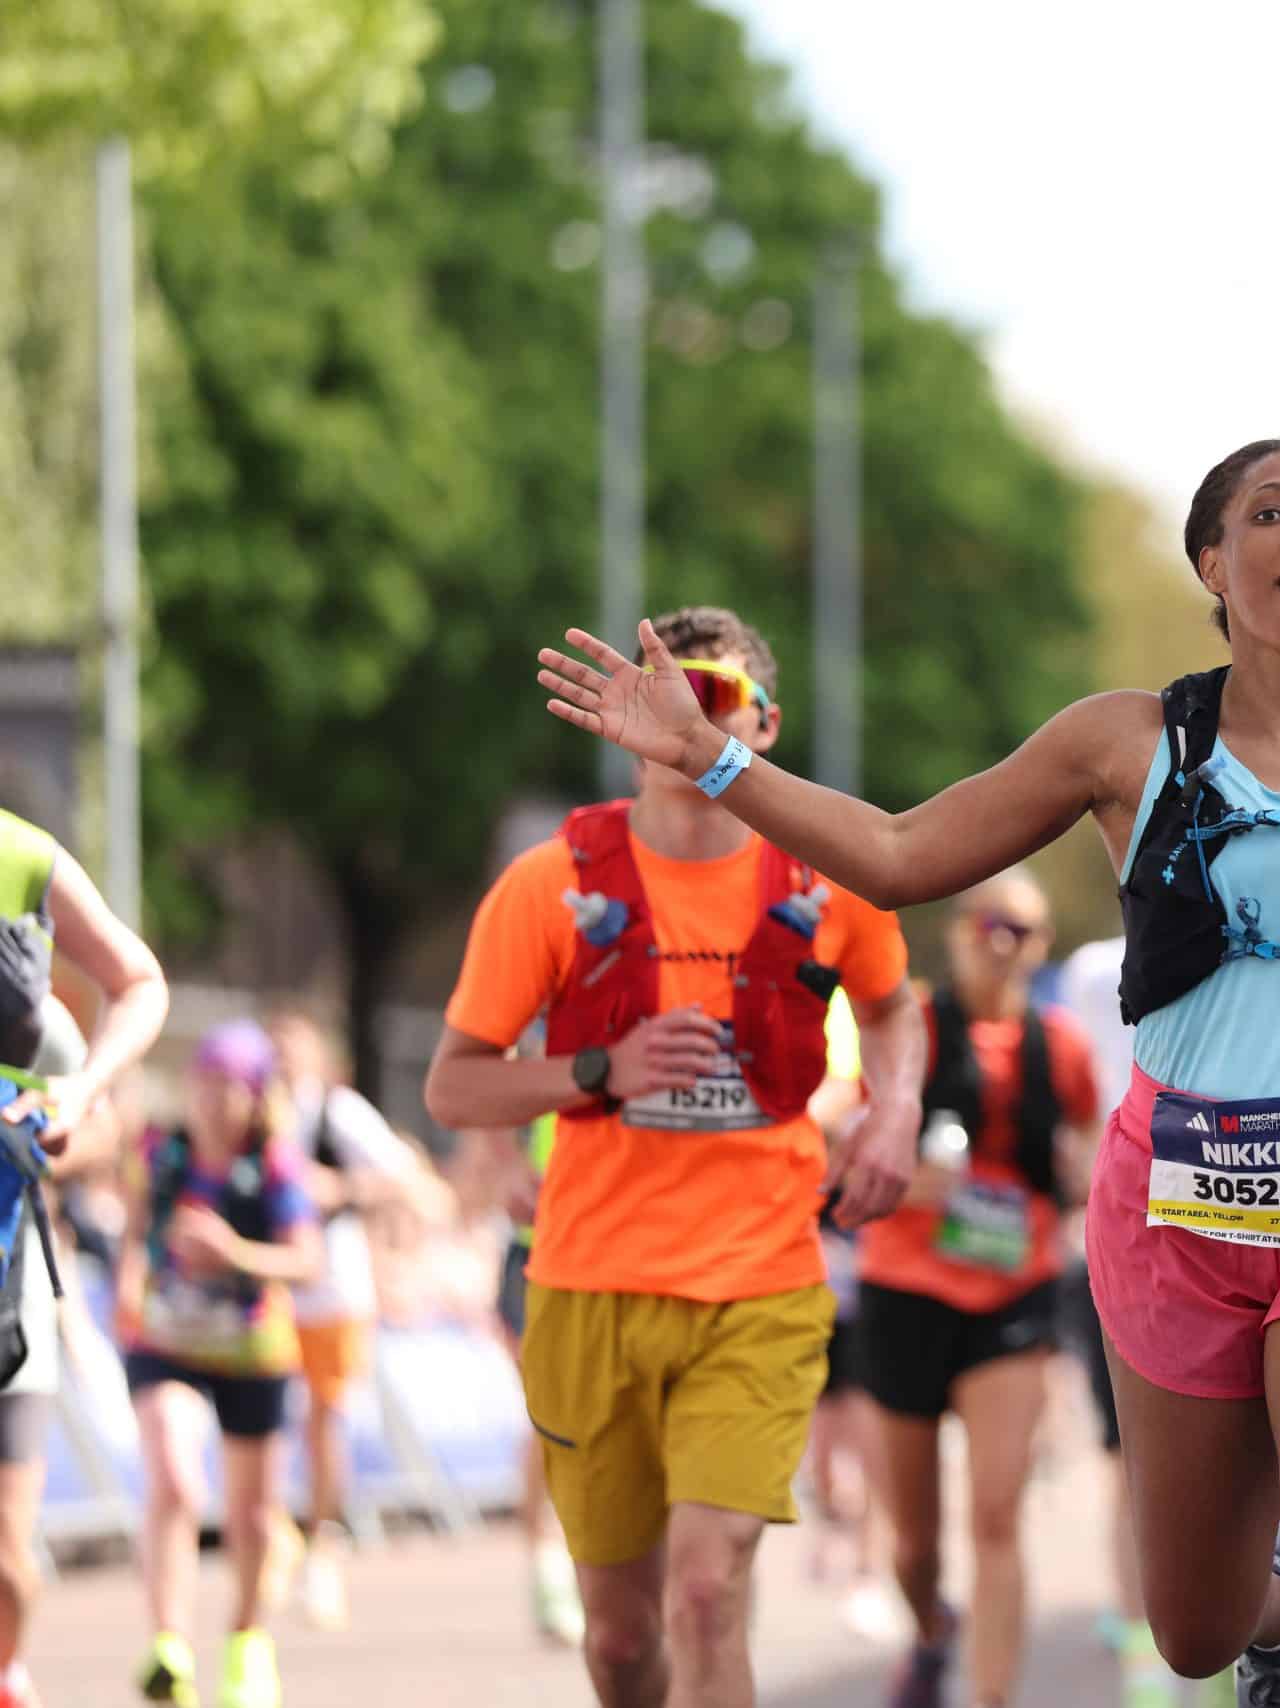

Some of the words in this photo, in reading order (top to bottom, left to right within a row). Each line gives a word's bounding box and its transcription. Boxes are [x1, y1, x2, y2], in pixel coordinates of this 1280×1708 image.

[669, 1086, 747, 1108] 15219
[1161, 1208, 1186, 1217] START
[1187, 1209, 1211, 1218] AREA:
[1213, 1211, 1244, 1221] YELLOW
[1230, 1232, 1260, 1242] T-SHIRT
[1262, 1235, 1272, 1243] AT
